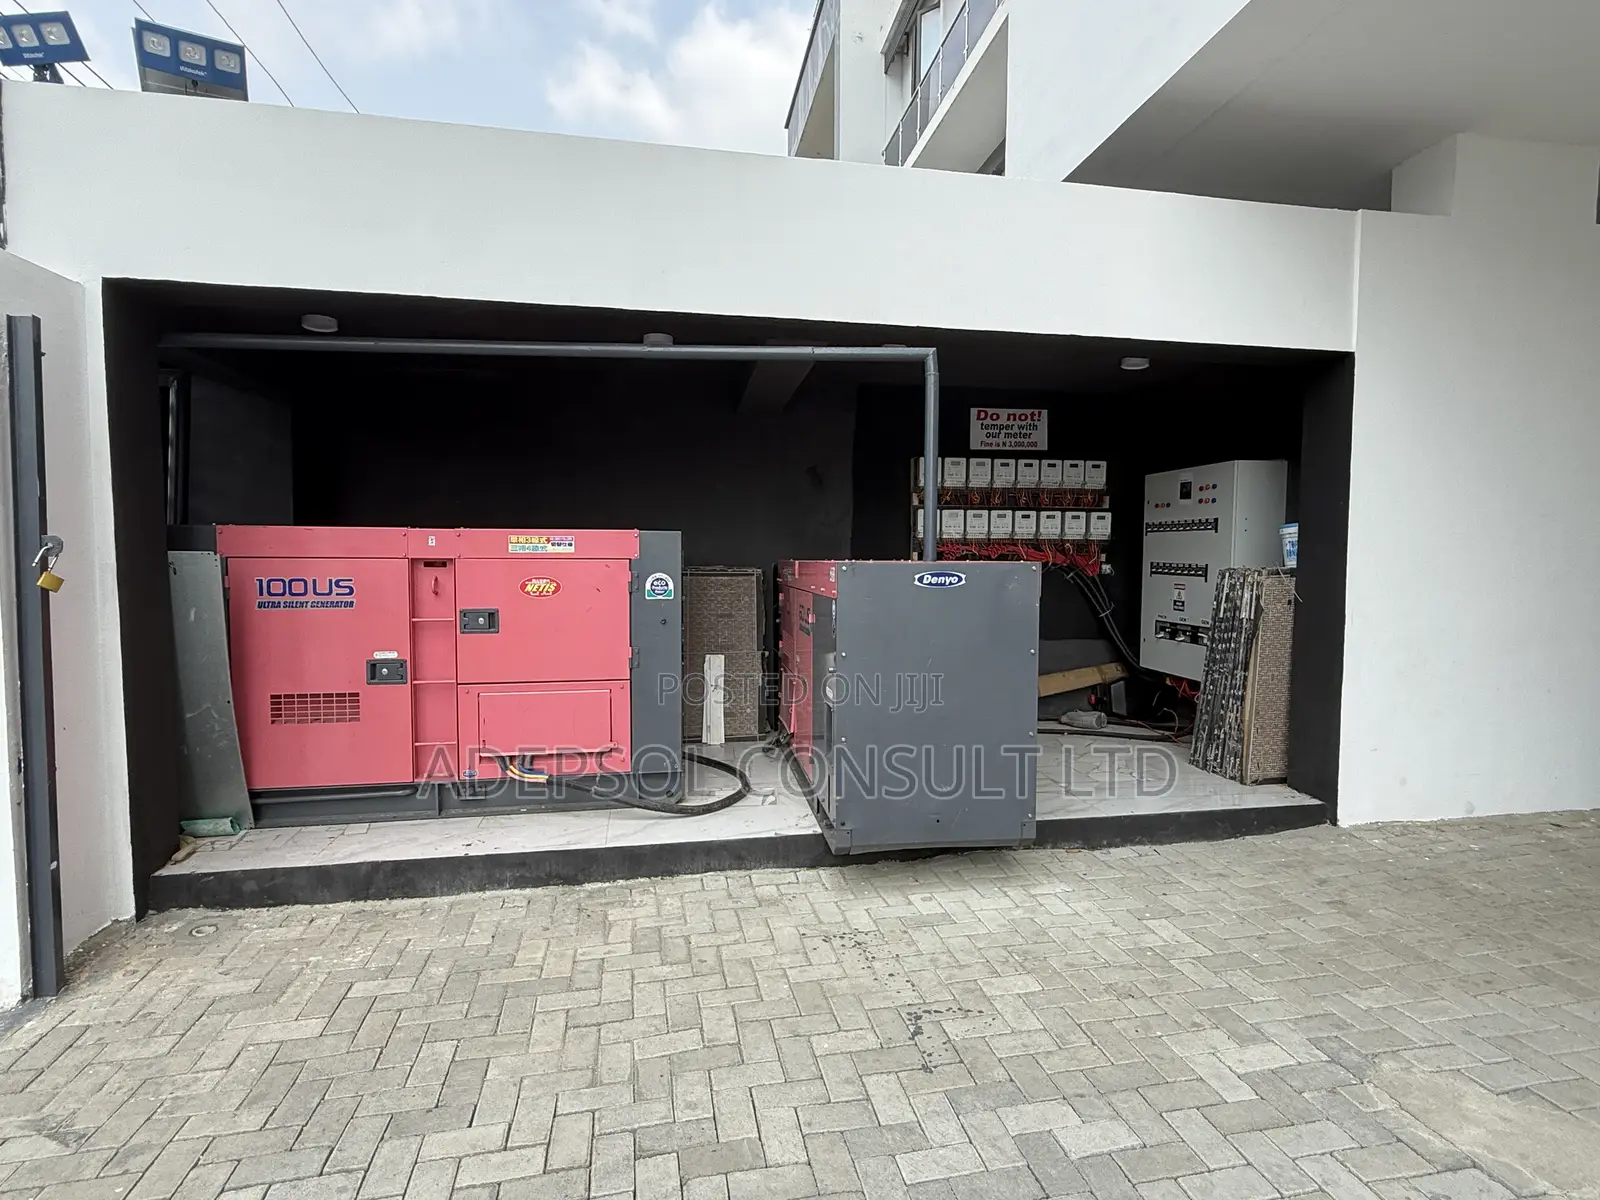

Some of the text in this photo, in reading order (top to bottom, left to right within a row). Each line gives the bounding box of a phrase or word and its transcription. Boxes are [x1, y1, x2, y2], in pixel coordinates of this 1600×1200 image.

[976, 409, 1042, 422] Do not!
[980, 422, 1038, 433] temper with
[985, 431, 1033, 439] our meter
[980, 440, 993, 448] Fine
[922, 574, 959, 586] Denyo
[524, 583, 557, 592] NETIS
[257, 600, 355, 609] ULTRA SILENT GENERATOR
